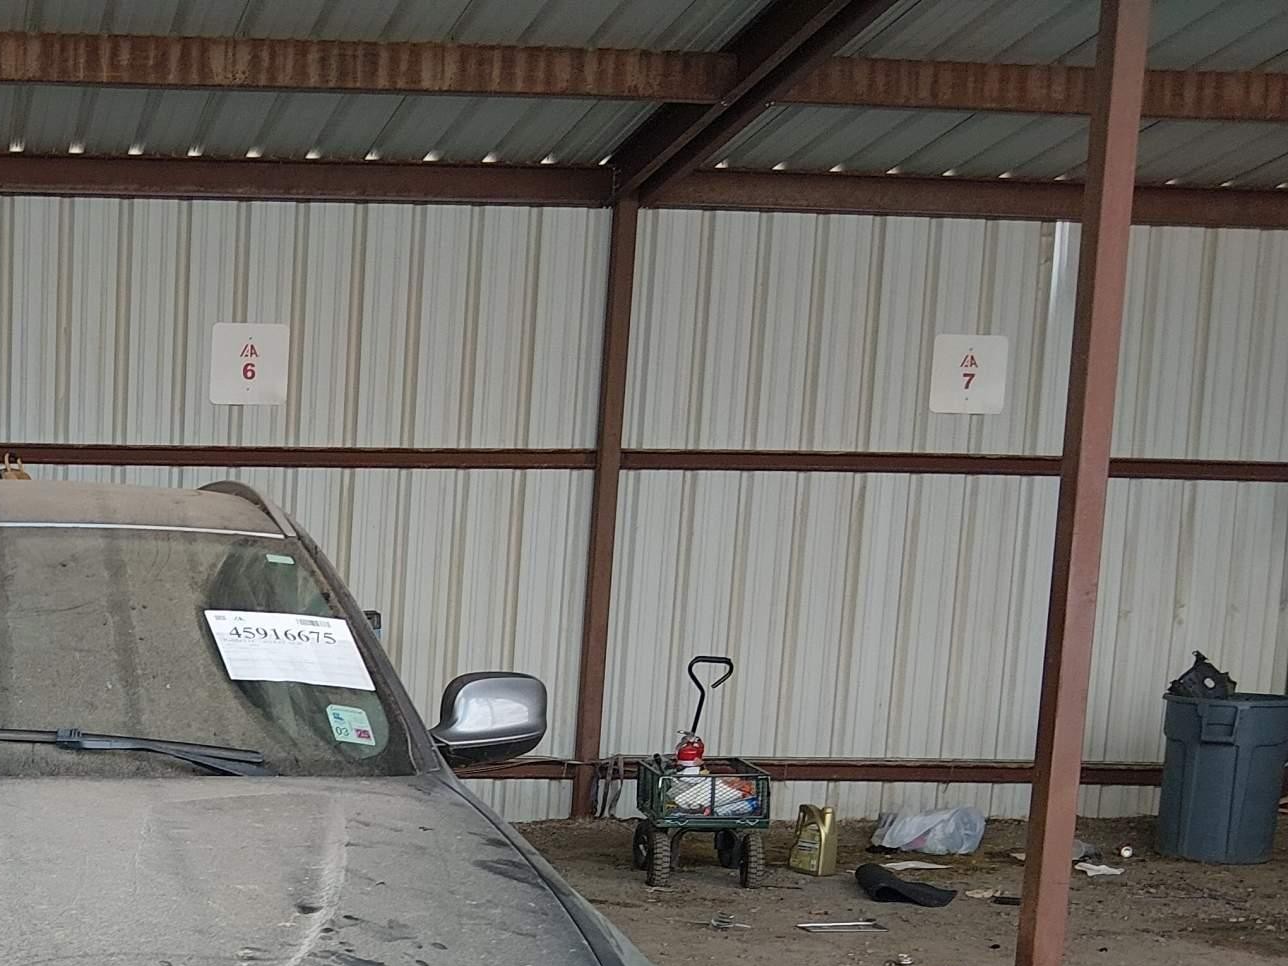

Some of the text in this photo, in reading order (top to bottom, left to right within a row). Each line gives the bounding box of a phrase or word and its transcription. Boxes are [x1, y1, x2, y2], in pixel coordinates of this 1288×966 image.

[242, 363, 256, 380] 6
[962, 373, 977, 390] 7
[228, 626, 337, 645] 45916675
